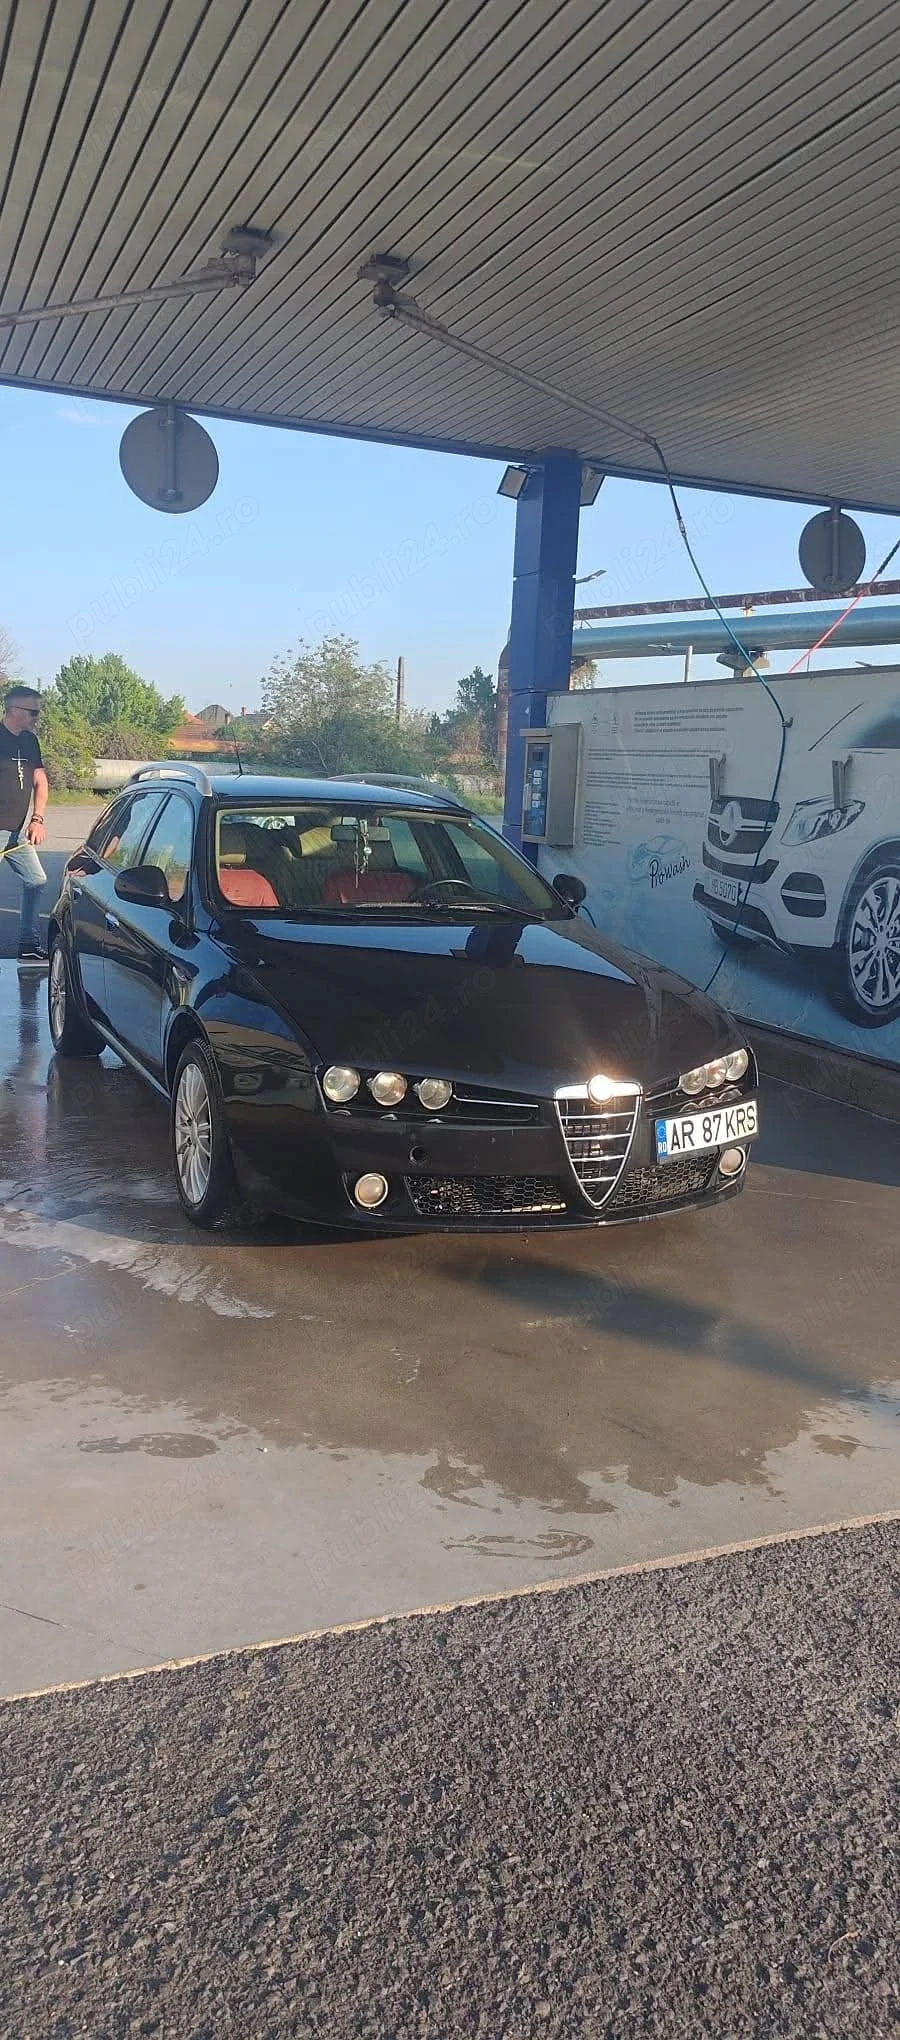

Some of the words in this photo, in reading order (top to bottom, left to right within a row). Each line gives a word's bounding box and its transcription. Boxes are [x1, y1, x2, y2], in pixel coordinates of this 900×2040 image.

[670, 1120, 695, 1151] AR
[702, 1114, 722, 1143] 87
[725, 1105, 756, 1139] KRS
[657, 1141, 667, 1153] RO
